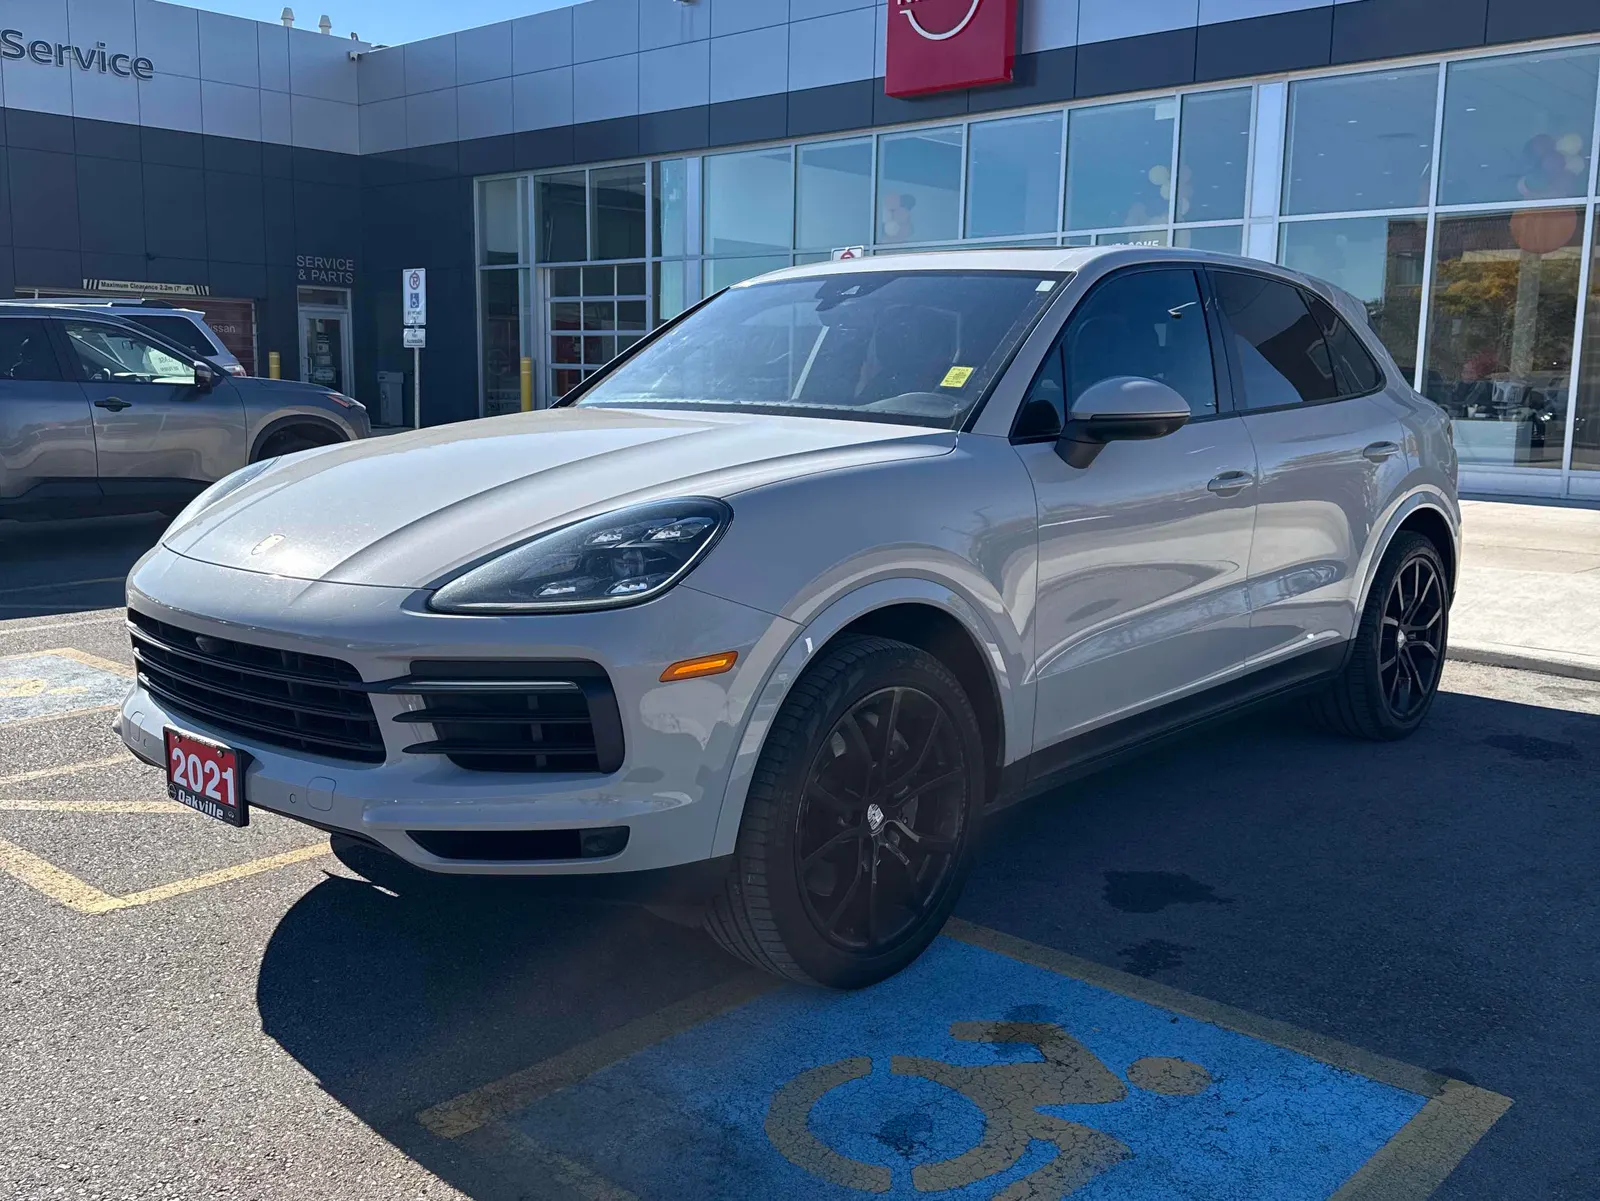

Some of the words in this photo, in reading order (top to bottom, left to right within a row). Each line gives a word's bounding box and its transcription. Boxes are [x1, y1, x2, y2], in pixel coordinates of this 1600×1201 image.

[0, 29, 154, 80] Service
[296, 255, 354, 271] SERVICE
[298, 268, 307, 281] &
[311, 269, 354, 284] PARTS
[101, 281, 129, 289] Maximum
[130, 282, 158, 291] Clearance
[208, 323, 236, 333] issan
[172, 747, 235, 806] 2021
[178, 790, 224, 820] Oakville
